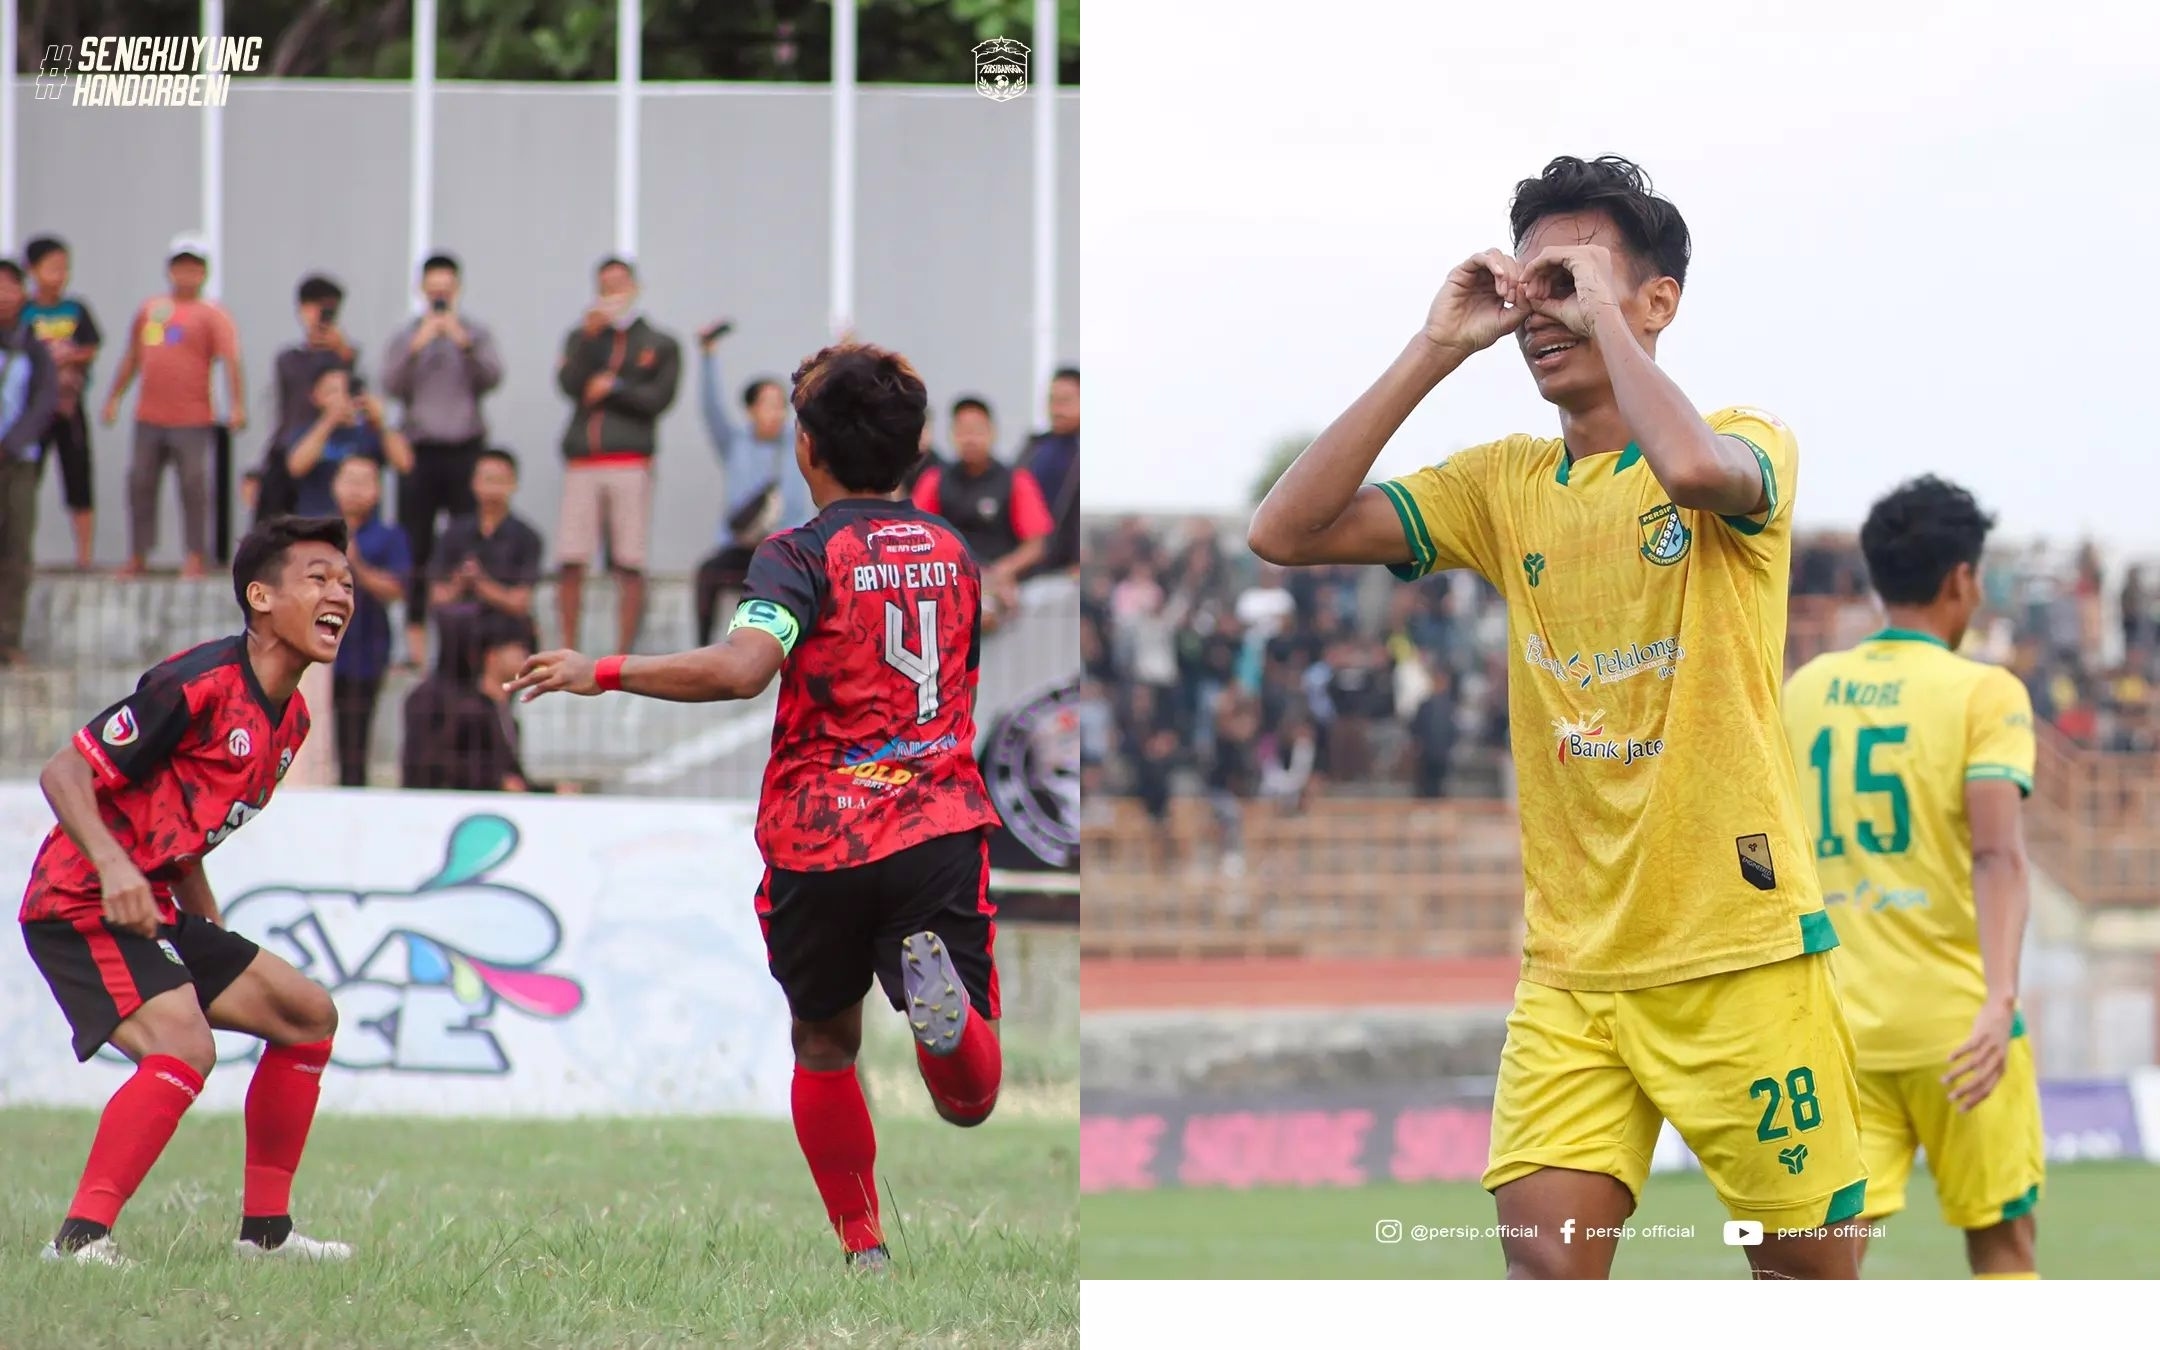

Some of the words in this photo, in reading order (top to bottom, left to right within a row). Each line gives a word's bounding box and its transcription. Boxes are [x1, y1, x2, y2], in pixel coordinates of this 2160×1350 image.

[1643, 505, 1672, 522] PERSIP
[854, 564, 900, 592] BAYU
[885, 600, 940, 725] 4
[1570, 733, 1620, 758] Bank
[838, 796, 870, 809] BLA
[1810, 725, 1912, 858] 15
[1749, 1066, 1824, 1144] 28
